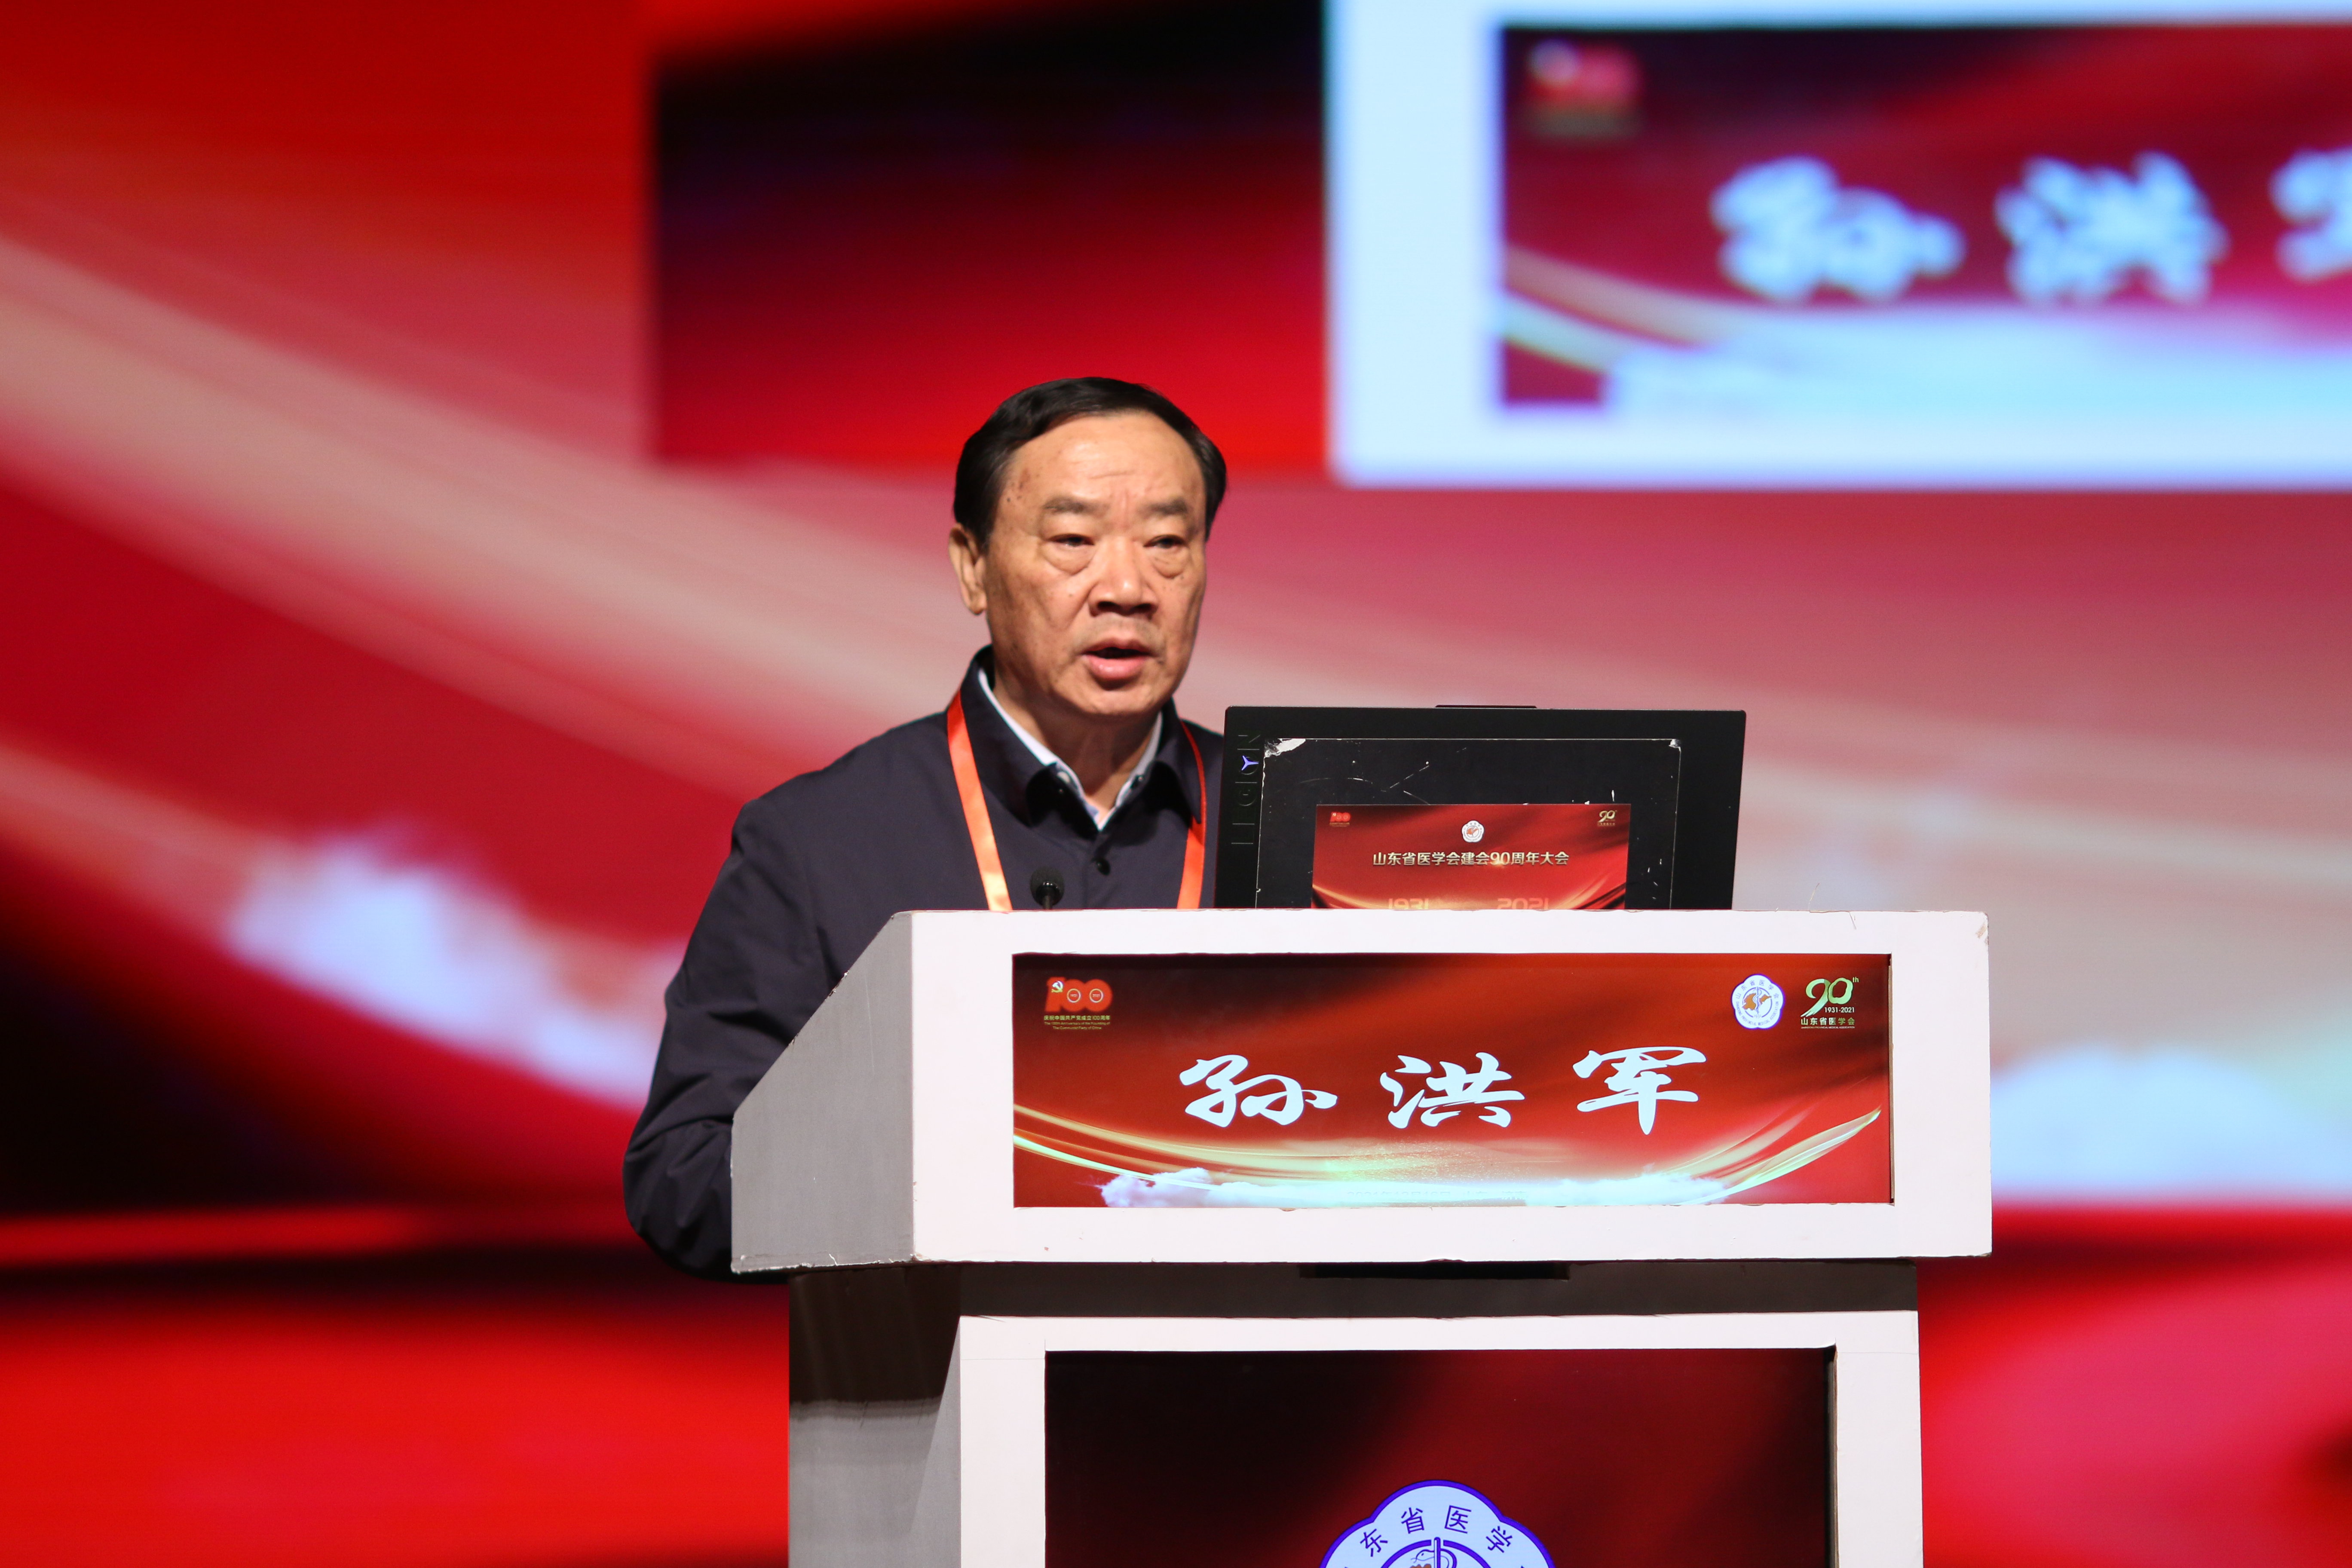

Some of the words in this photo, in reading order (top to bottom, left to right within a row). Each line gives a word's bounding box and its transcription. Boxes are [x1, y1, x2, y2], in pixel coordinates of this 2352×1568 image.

[1373, 851, 1569, 865] 山东省医学会建会90周年大会
[1801, 1017, 1855, 1026] 山东省医学会
[1179, 1046, 1707, 1135] 孙洪军
[1344, 1505, 1524, 1568] 东省医学
